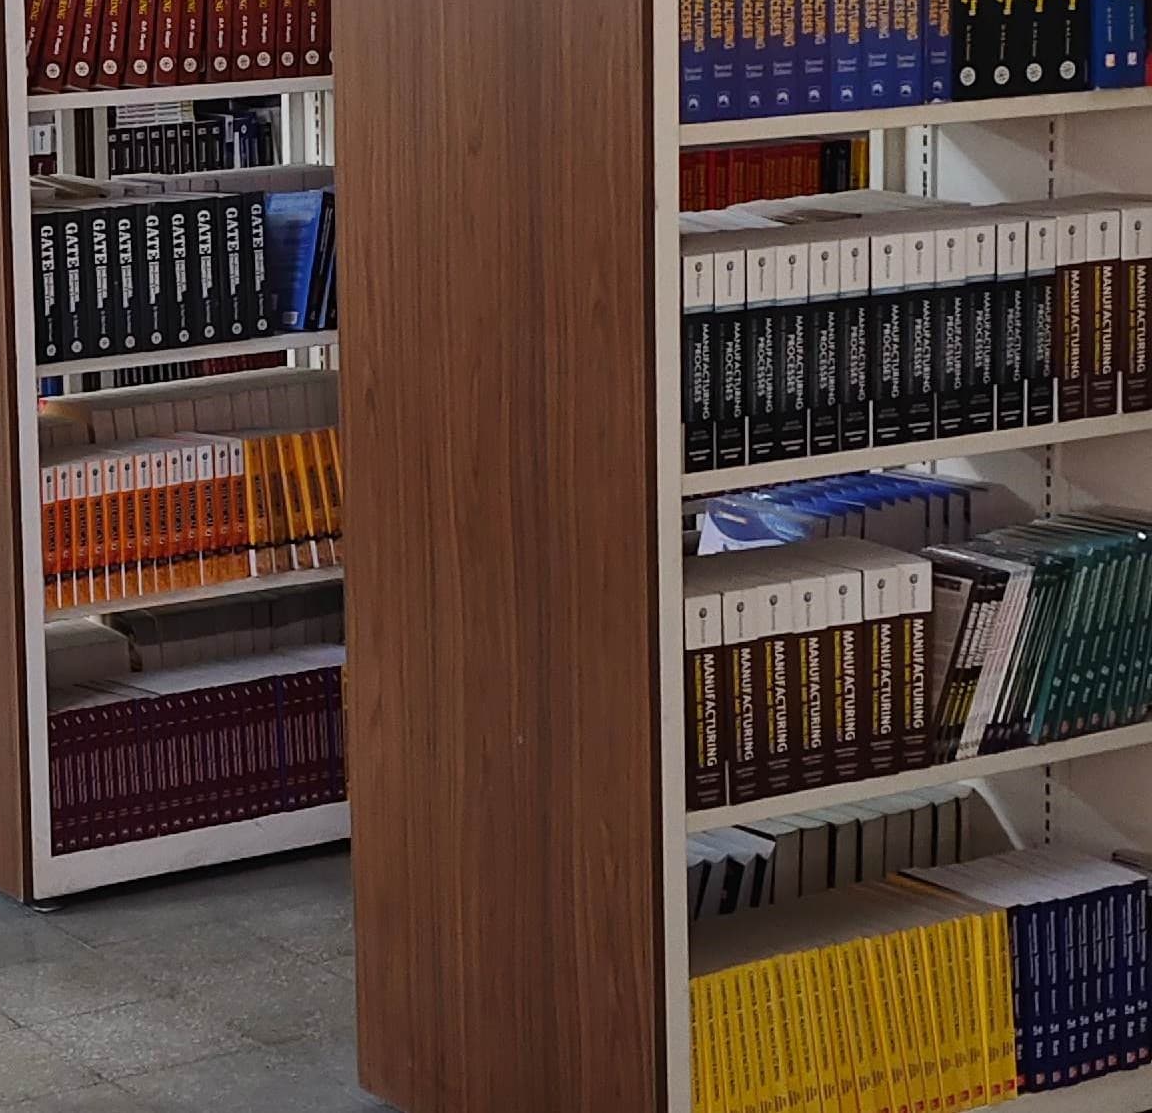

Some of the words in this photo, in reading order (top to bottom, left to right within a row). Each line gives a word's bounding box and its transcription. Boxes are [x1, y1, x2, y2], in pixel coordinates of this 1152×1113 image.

[40, 225, 54, 271] GATE
[65, 223, 80, 269] GATE
[92, 219, 108, 265] GATE
[118, 218, 132, 265] GATE
[146, 215, 159, 261] GATE
[171, 213, 185, 258] GATE
[197, 209, 212, 255] GATE
[225, 207, 240, 252] GATE
[251, 204, 264, 249] GATE
[1069, 269, 1079, 379] MANUFACTURING
[1102, 265, 1112, 375] MANUFACTURING
[1136, 265, 1146, 373] MANUFACTURING
[702, 323, 710, 420] MANUFACTURING
[703, 653, 717, 766] MANUFACTURING
[739, 647, 755, 760] MANUFACTURING
[773, 641, 787, 754] MANUFACTURING
[808, 637, 821, 749] MANUFACTURING
[842, 630, 856, 741] MANUFACTURING
[880, 623, 892, 735] MANUFACTURING
[912, 618, 924, 728] MANUFACTURING
